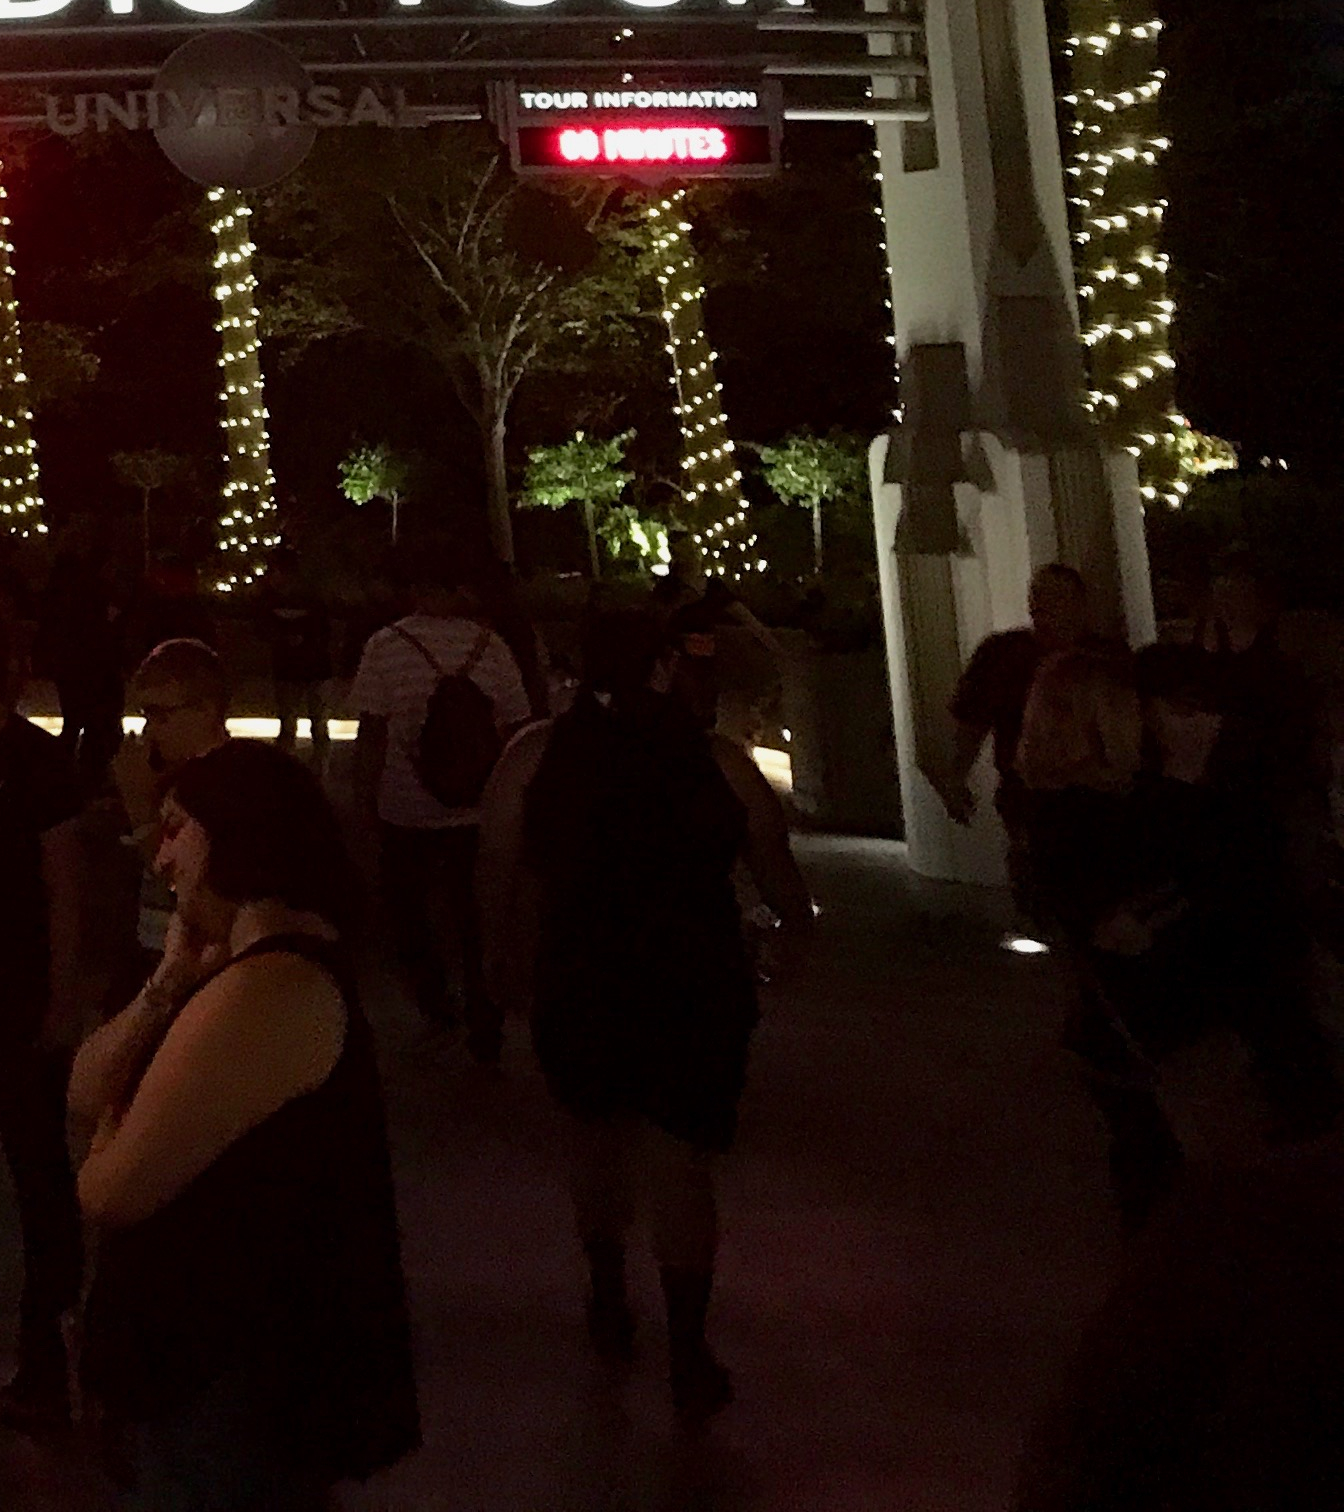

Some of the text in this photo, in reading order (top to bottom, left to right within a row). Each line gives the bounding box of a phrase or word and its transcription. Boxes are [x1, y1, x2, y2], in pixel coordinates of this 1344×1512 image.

[45, 84, 429, 136] UNIVERSAL
[520, 91, 758, 109] TOUR INFORMATION
